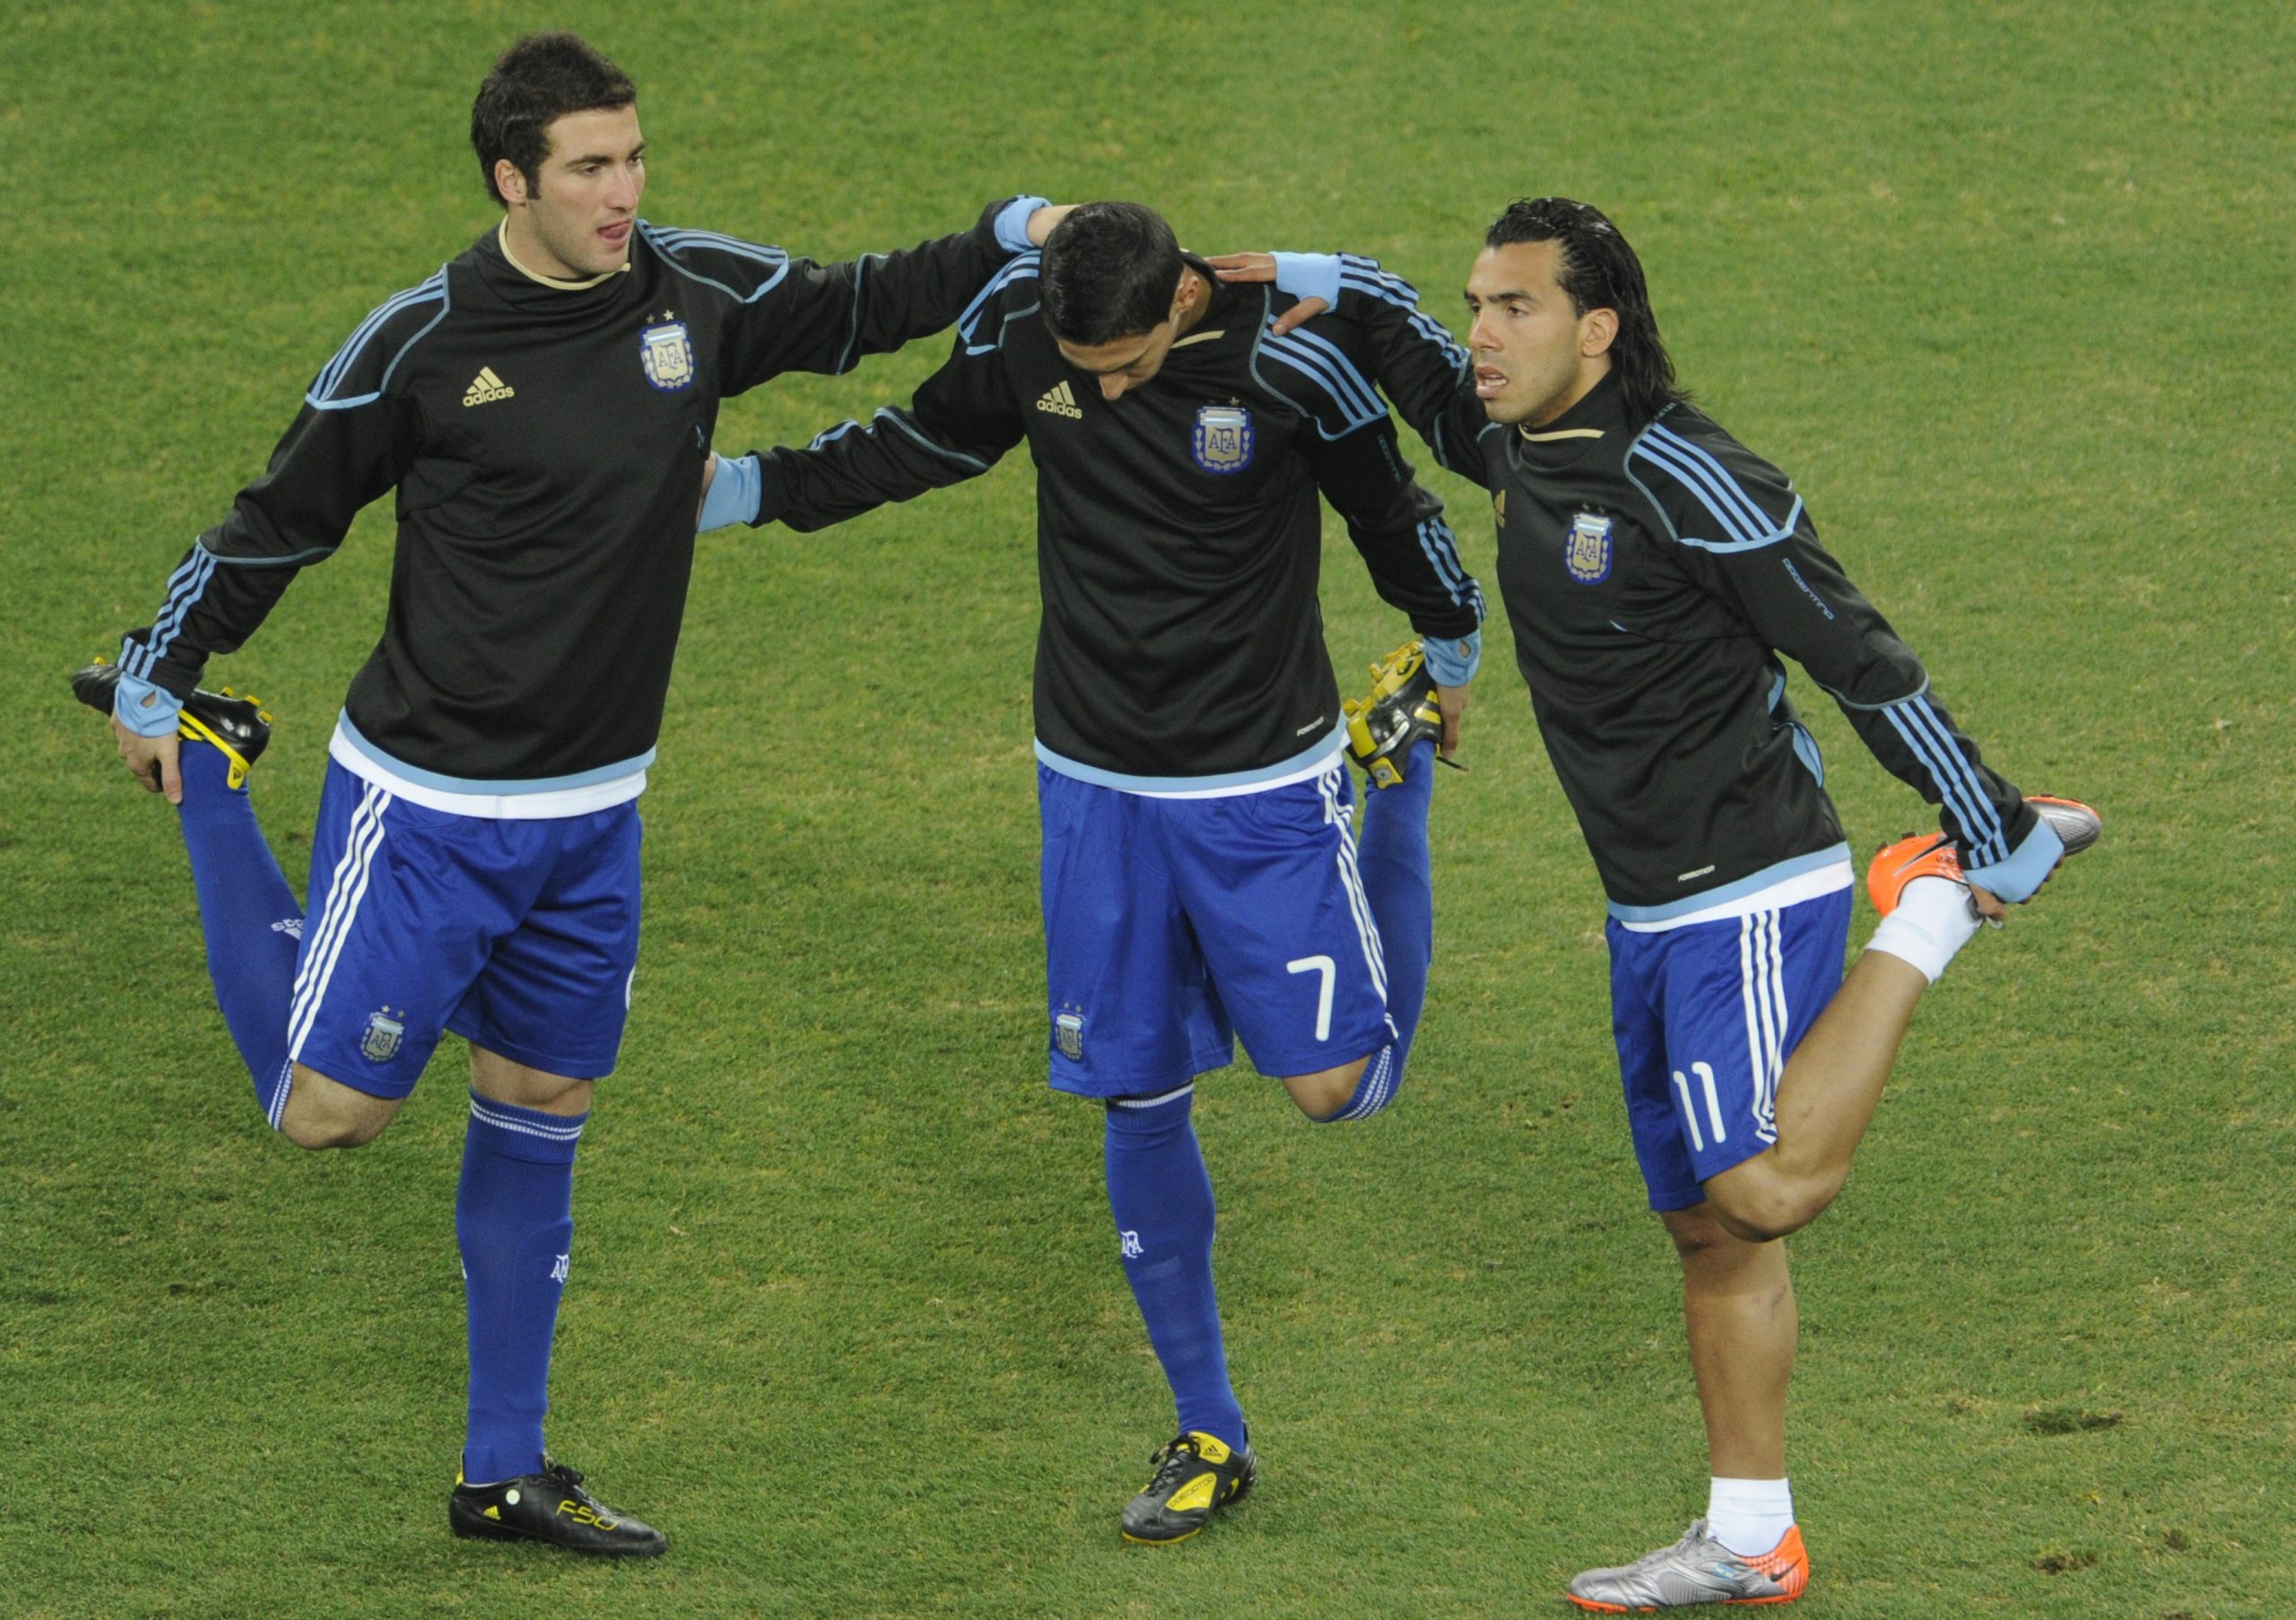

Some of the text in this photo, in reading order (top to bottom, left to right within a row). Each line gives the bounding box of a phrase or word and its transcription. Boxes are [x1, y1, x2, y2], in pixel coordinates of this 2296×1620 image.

[658, 342, 684, 370] AFA
[463, 387, 515, 407] adidas
[1036, 398, 1083, 419] adidas
[1208, 426, 1238, 454] AFA
[1575, 534, 1597, 562] AFA
[1286, 954, 1336, 1041] 7
[371, 1030, 392, 1050] AFA
[1673, 1061, 1726, 1153] 11
